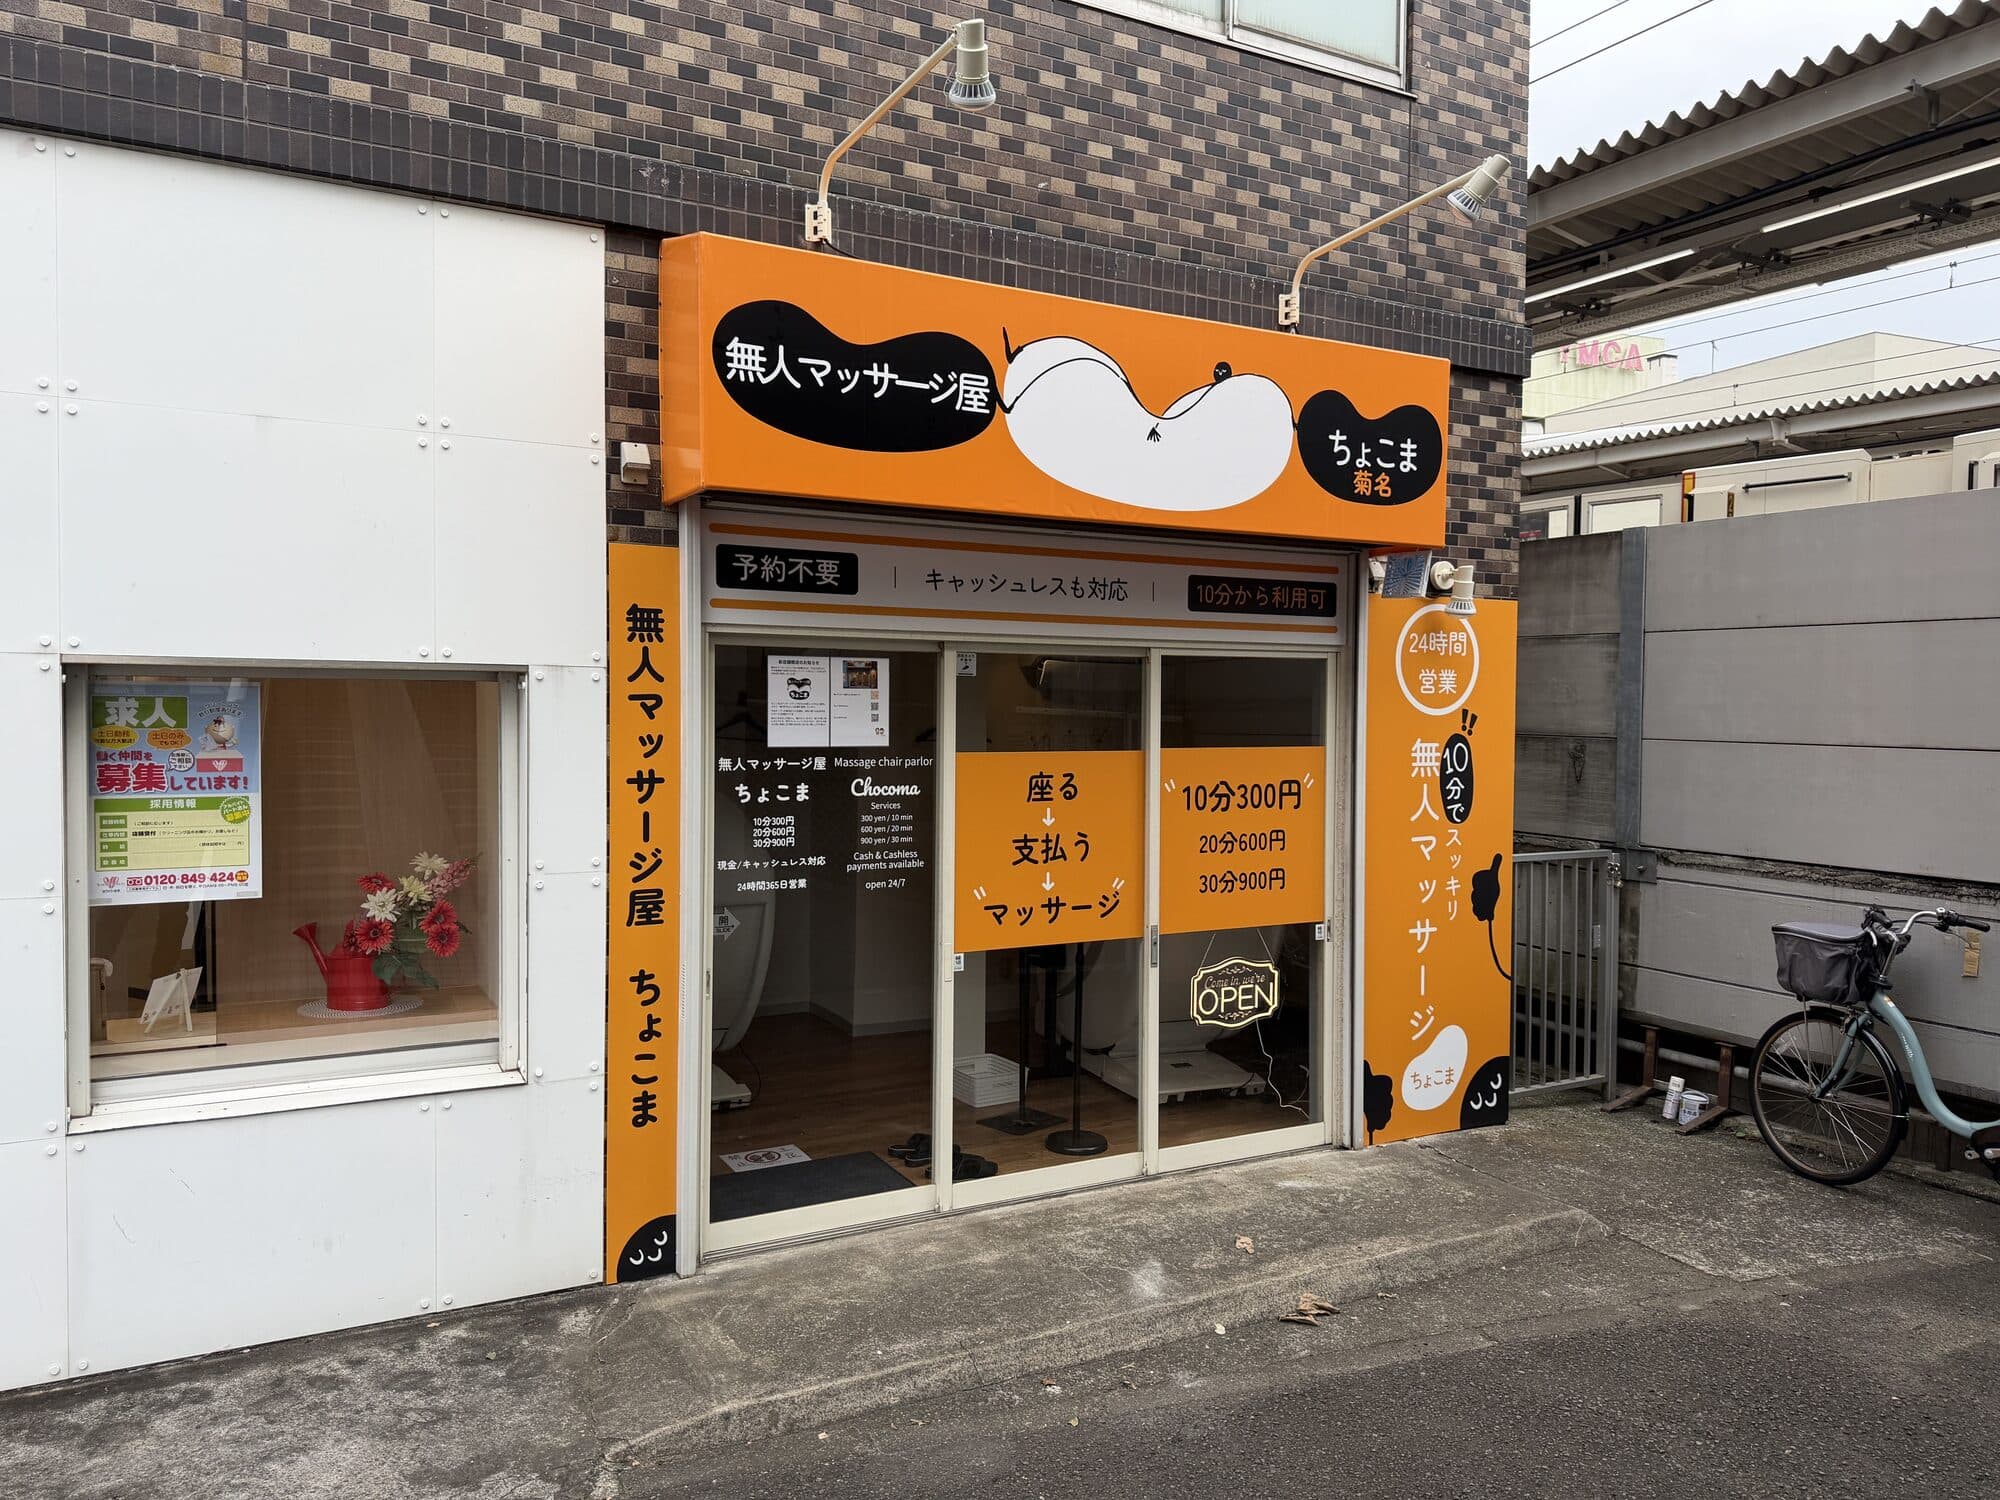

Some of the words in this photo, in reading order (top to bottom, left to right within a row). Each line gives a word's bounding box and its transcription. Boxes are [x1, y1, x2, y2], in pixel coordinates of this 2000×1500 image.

[725, 336, 990, 414] 無人マッサージ屋
[1328, 429, 1418, 472] ちょこま
[1353, 470, 1393, 498] 菊名
[732, 553, 842, 587] 予約不要
[925, 569, 1129, 602] キャッシュレスも対応
[1196, 583, 1326, 611] 10分から利用可
[1409, 630, 1467, 657] 24時間
[1418, 668, 1457, 694] 営業
[105, 697, 176, 728] 求人
[96, 751, 153, 761] 働く仲間を
[625, 603, 666, 927] 無人マッサージ屋
[718, 757, 826, 771] 無人マッサージ屋
[834, 757, 876, 769] Massage
[878, 757, 901, 767] chair
[904, 757, 933, 769] parlor
[96, 763, 167, 792] 募集
[170, 776, 249, 791] しています!
[851, 776, 920, 797] Chocoma
[1026, 771, 1078, 803] 座る
[150, 799, 196, 809] 採用情報
[735, 783, 809, 803] ちょこま
[1181, 779, 1302, 813] 10分300円
[871, 802, 901, 810] Services
[753, 816, 794, 826] 10分300円
[861, 815, 872, 823] 300
[874, 816, 886, 824] yen
[891, 814, 899, 822] 10
[861, 825, 872, 833] 600
[874, 826, 886, 834] yen
[891, 824, 899, 832] 20
[753, 827, 795, 837] 20分600円
[753, 837, 795, 848] 30分900円
[861, 836, 872, 844] 900
[874, 837, 886, 845] yen
[891, 835, 899, 843] 30
[1199, 829, 1286, 854] 20分600円
[854, 852, 874, 861] Cash
[875, 852, 882, 860] &
[883, 850, 918, 859] Cashless
[1012, 831, 1090, 866] 支払う
[717, 856, 826, 871] 現金/キャッシュレス対応
[846, 861, 887, 872] payments
[889, 859, 924, 869] available
[737, 878, 807, 891] 24時間365日営業
[865, 881, 886, 890] open
[888, 878, 906, 888] 24/7
[1199, 868, 1286, 894] 30分900円
[1408, 738, 1441, 1041] 無人マッサージ
[984, 891, 1120, 926] マッサージ
[1204, 976, 1228, 990] Come
[1242, 972, 1265, 984] we're
[1199, 982, 1274, 1015] OPEN
[629, 969, 662, 1128] ちょこま
[1411, 1066, 1455, 1090] ちょこま
